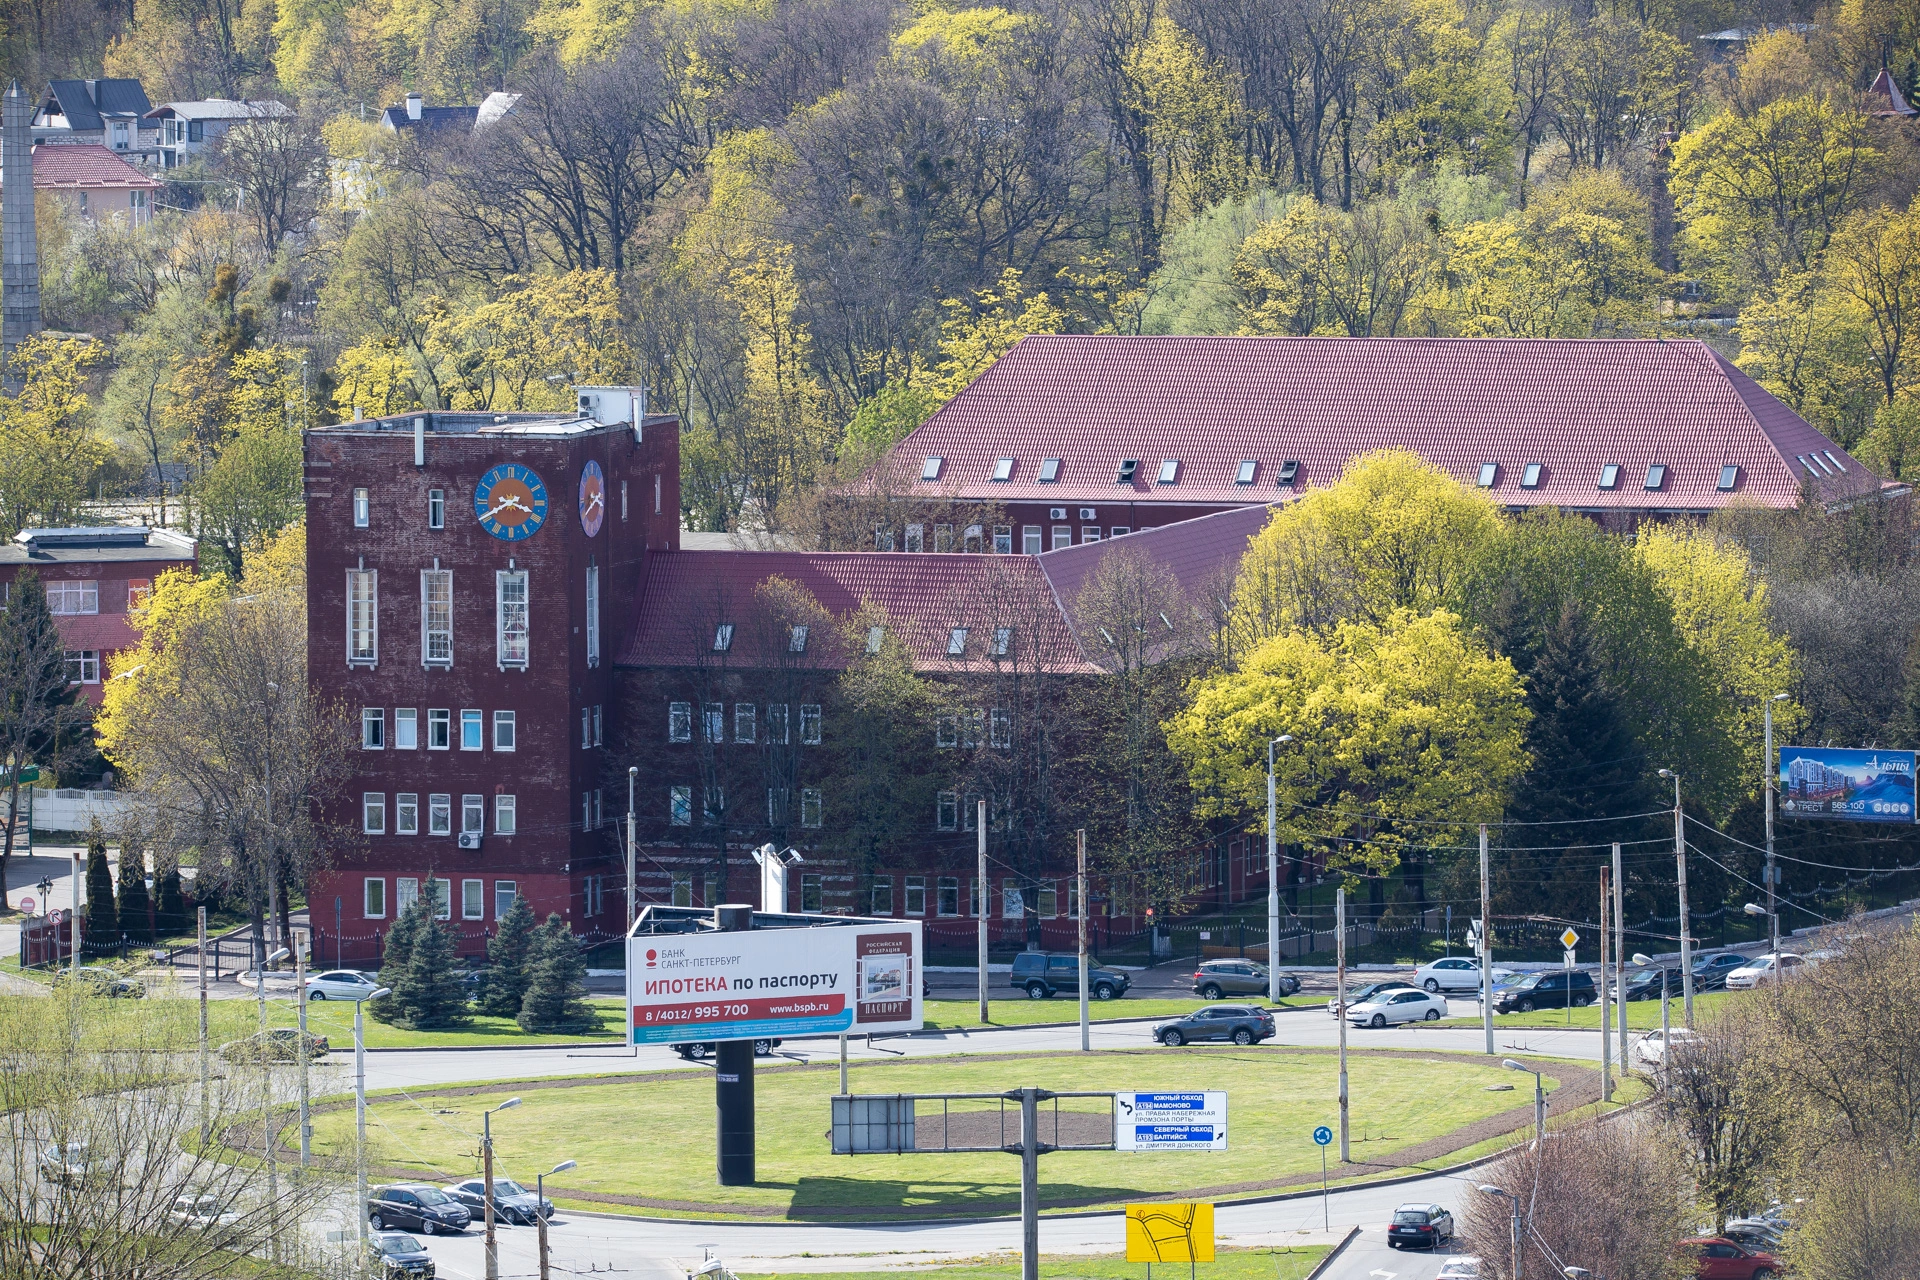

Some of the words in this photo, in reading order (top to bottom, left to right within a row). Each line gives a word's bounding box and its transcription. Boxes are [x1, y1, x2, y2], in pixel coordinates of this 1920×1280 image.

[1863, 754, 1910, 771] Альпы
[1797, 804, 1824, 812] ТРЕСТ
[661, 949, 686, 959] БАНК
[661, 955, 741, 969] САНКТ-ПЕТЕРБУРГ
[645, 976, 728, 995] ИПОТЕКА
[733, 978, 754, 990] по
[759, 973, 838, 989] паспорту
[645, 1012, 653, 1021] 8
[655, 1009, 692, 1022] /4012/
[694, 1006, 720, 1018] 995
[724, 1004, 749, 1016] 700
[769, 1003, 829, 1014] www.bspb.ru
[865, 1002, 904, 1014] ПАСПОРТ
